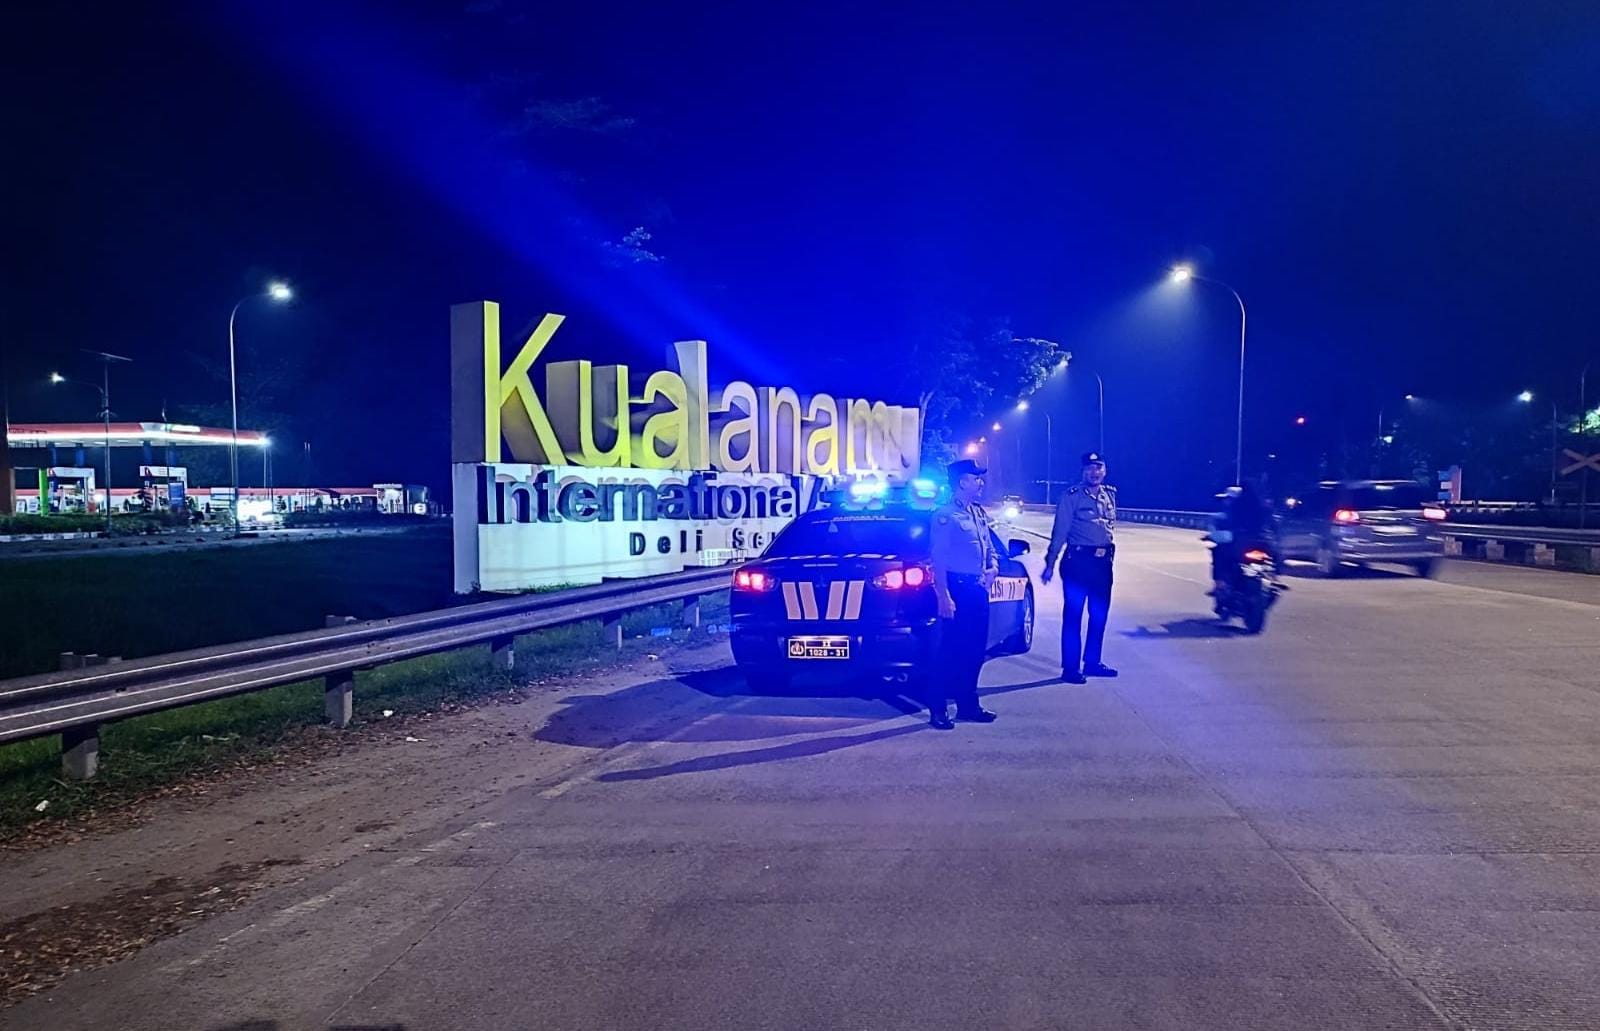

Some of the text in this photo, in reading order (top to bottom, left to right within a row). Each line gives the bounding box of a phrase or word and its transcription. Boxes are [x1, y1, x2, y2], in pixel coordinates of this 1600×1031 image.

[483, 299, 919, 478] Kualanamu
[477, 463, 805, 525] International
[629, 529, 703, 556] Deli
